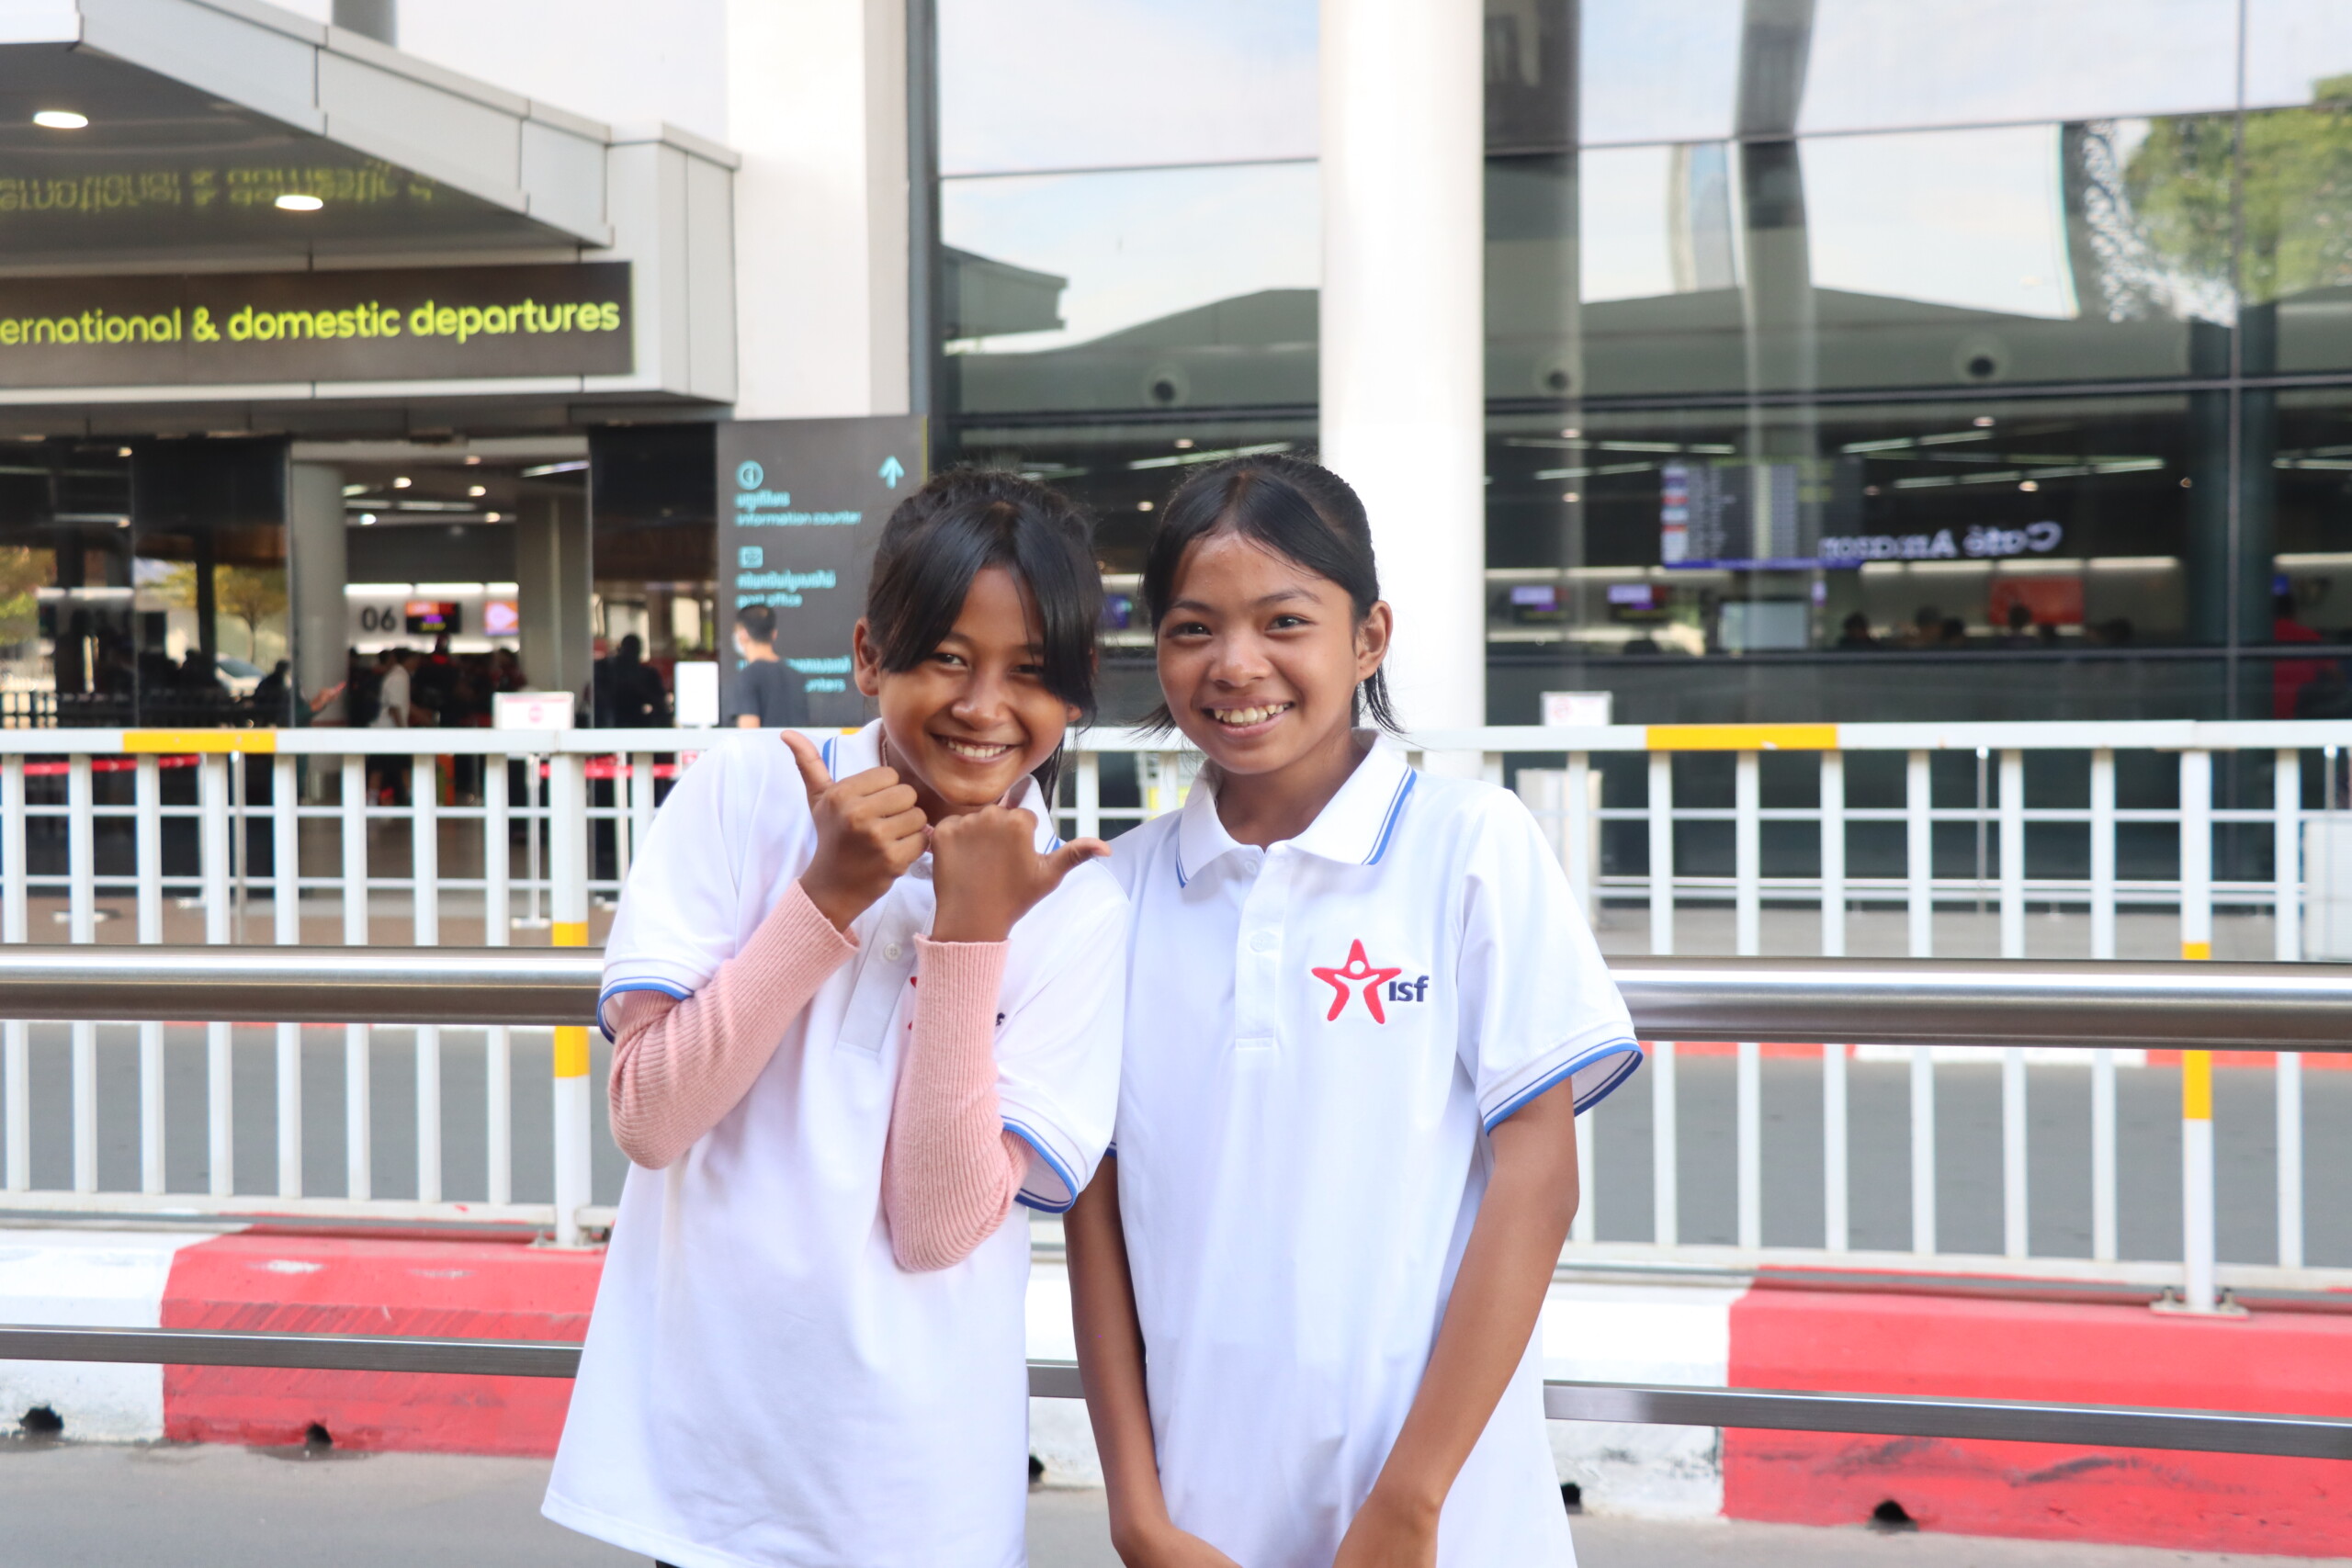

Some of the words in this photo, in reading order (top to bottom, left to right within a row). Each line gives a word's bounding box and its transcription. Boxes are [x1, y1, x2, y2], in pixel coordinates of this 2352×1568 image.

[0, 307, 182, 345] ernational
[192, 306, 220, 342] &
[229, 300, 401, 342] domestic
[410, 298, 621, 344] departures
[735, 511, 811, 527] information
[811, 510, 862, 526] counter
[361, 606, 396, 631] 06
